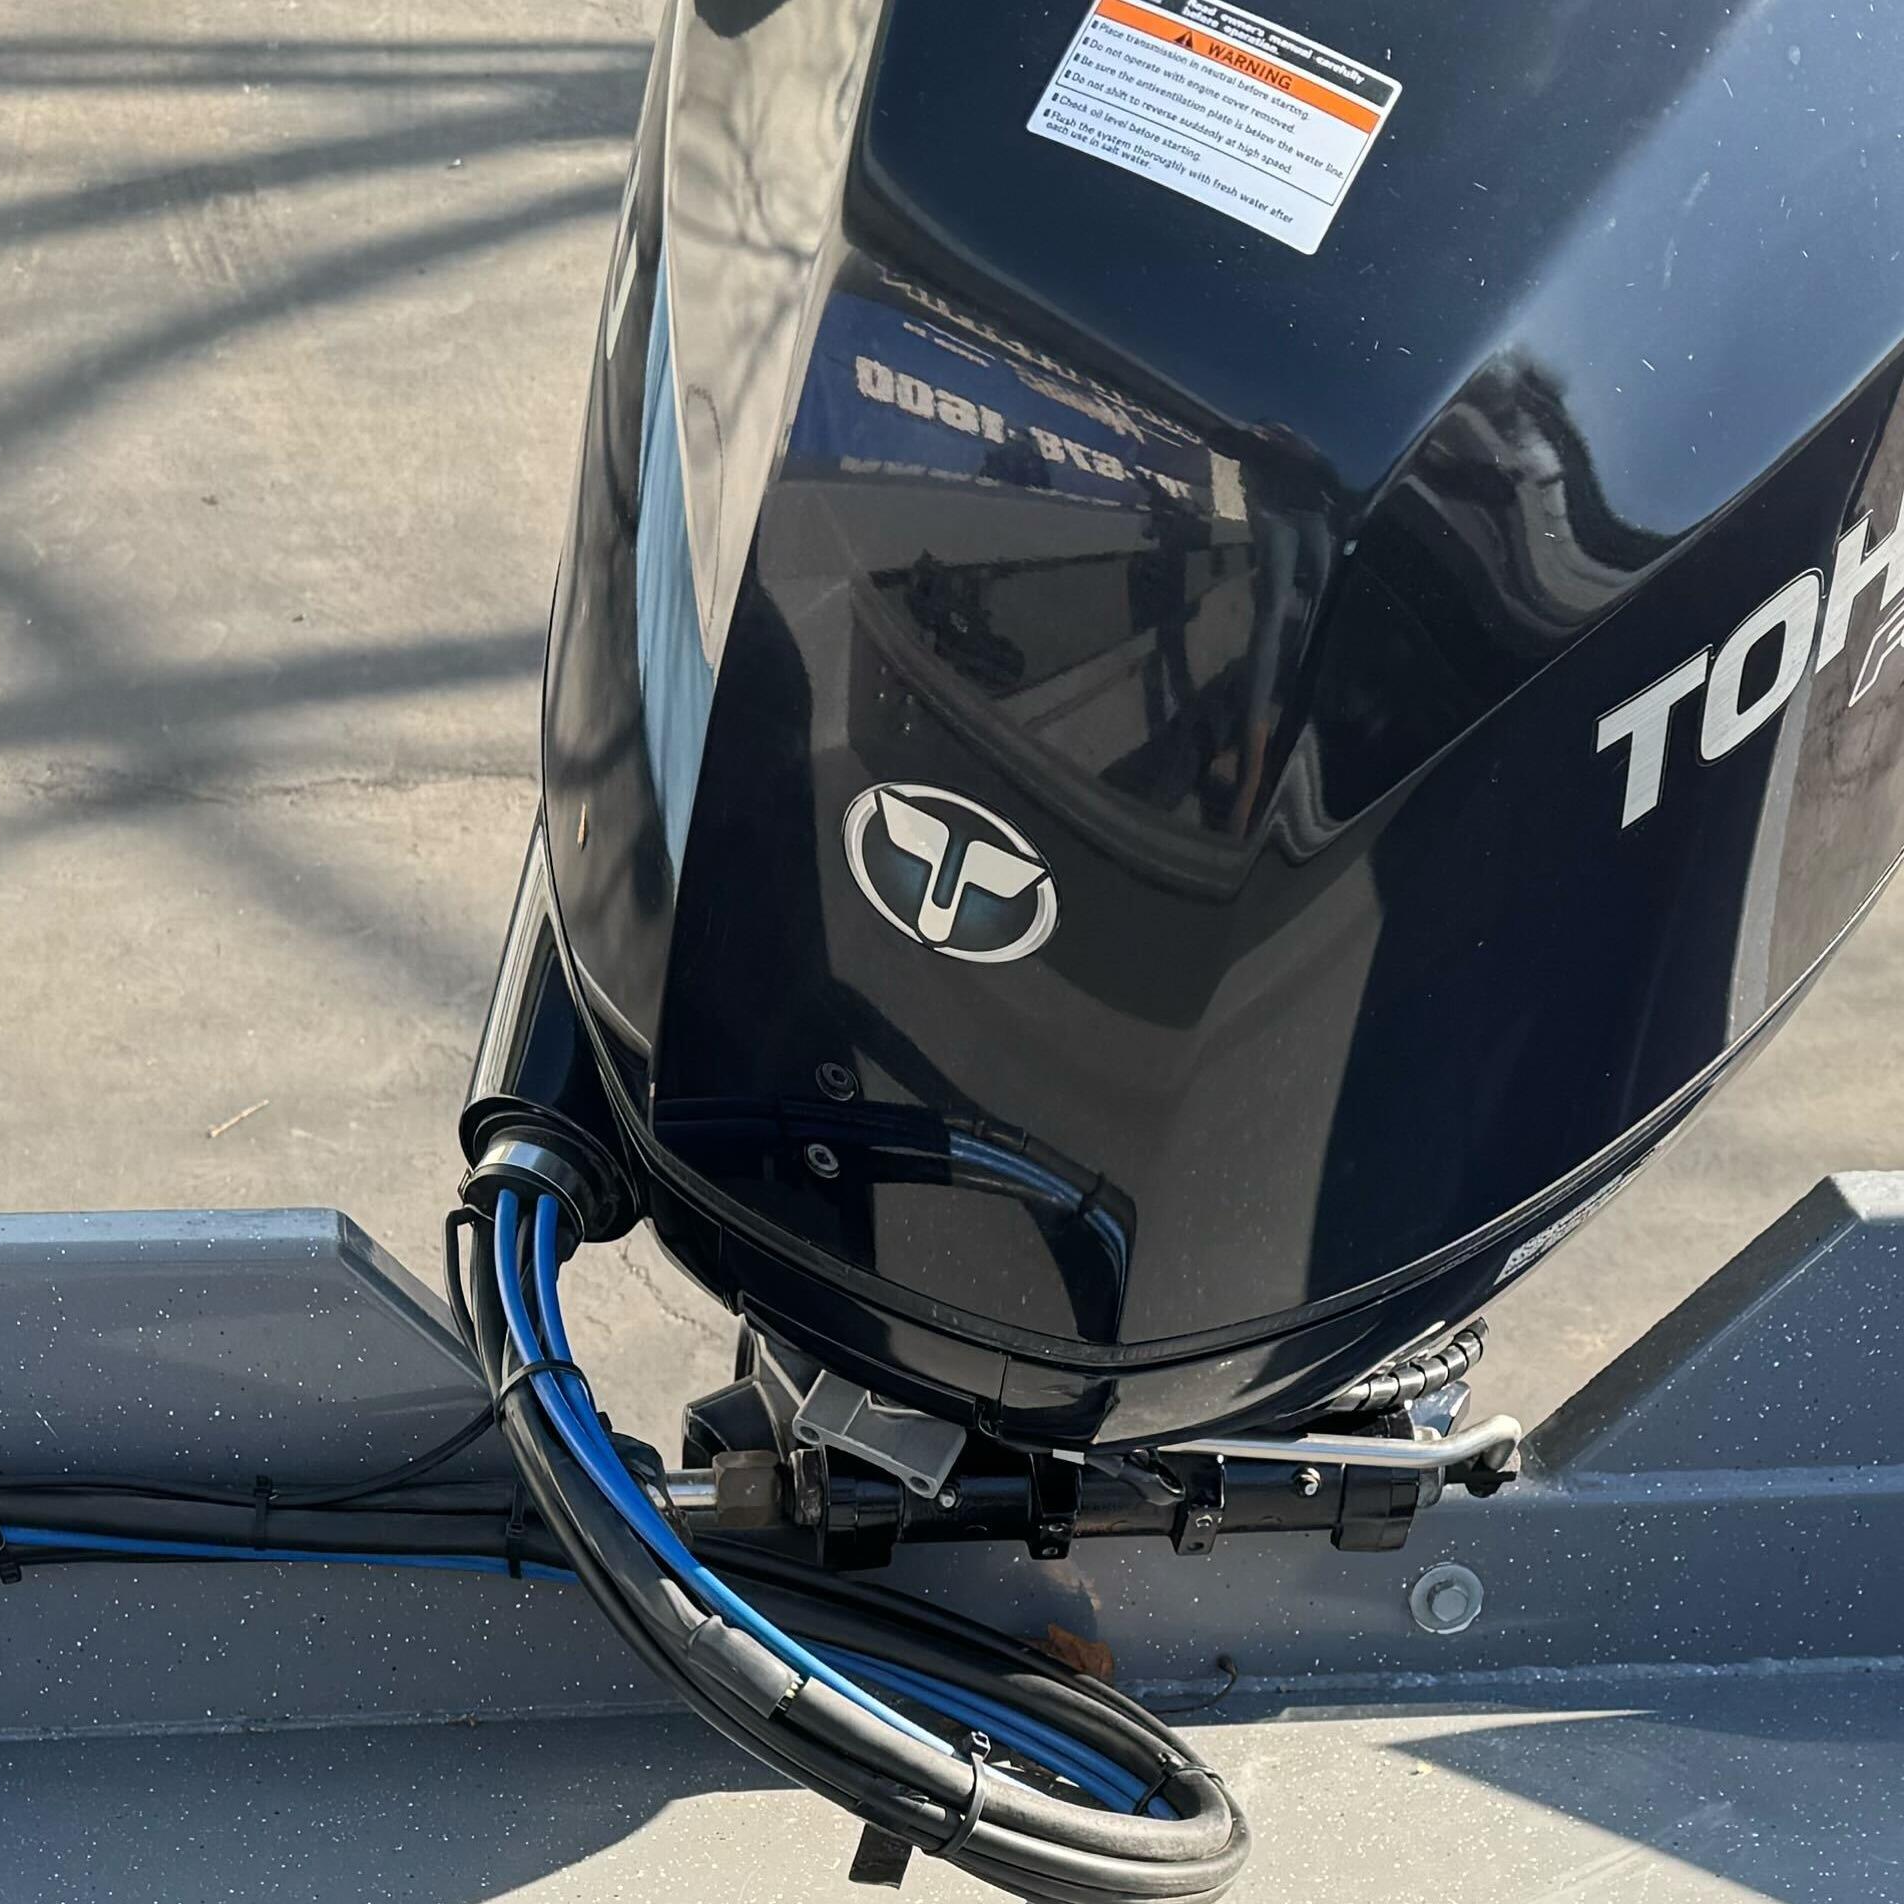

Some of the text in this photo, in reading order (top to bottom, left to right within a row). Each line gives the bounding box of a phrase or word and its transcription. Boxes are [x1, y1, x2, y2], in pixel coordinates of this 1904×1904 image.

[1182, 6, 1219, 29] before
[1090, 39, 1104, 50] Do
[1105, 46, 1122, 57] not
[1124, 56, 1161, 74] operate
[1163, 69, 1185, 84] with
[1187, 79, 1220, 98] engine
[1222, 96, 1248, 111] cover
[1099, 22, 1124, 39] Place
[1126, 33, 1187, 65] transmission
[1189, 57, 1199, 69] in
[1201, 63, 1236, 85] neutral
[1237, 80, 1269, 100] before
[1208, 43, 1293, 91] WARNING
[1269, 34, 1313, 60] manual
[1315, 55, 1366, 86] carefully
[1046, 121, 1069, 135] each
[1070, 131, 1088, 143] use
[1089, 138, 1099, 147] in
[1101, 142, 1120, 155] salt
[1059, 96, 1087, 112] Check
[1090, 108, 1103, 119] oil
[1104, 113, 1129, 129] level
[1130, 124, 1161, 143] before
[1072, 72, 1085, 84] Do
[1087, 80, 1104, 92] not
[1106, 86, 1128, 101] shift
[1130, 95, 1140, 105] to
[1142, 102, 1178, 121] reverse
[1179, 117, 1223, 143] suddenly
[1225, 138, 1236, 148] at
[1239, 144, 1260, 161] high
[1081, 54, 1093, 67] Be
[1095, 62, 1116, 75] sure
[1118, 69, 1134, 83] the
[1136, 78, 1206, 113] antiventilation
[1207, 107, 1233, 126] plate
[1234, 119, 1243, 129] is
[1246, 125, 1276, 144] below
[1278, 140, 1294, 154] the
[1296, 150, 1323, 168] water
[1050, 111, 1295, 224] Flush the system thoroughly with fresh water after
